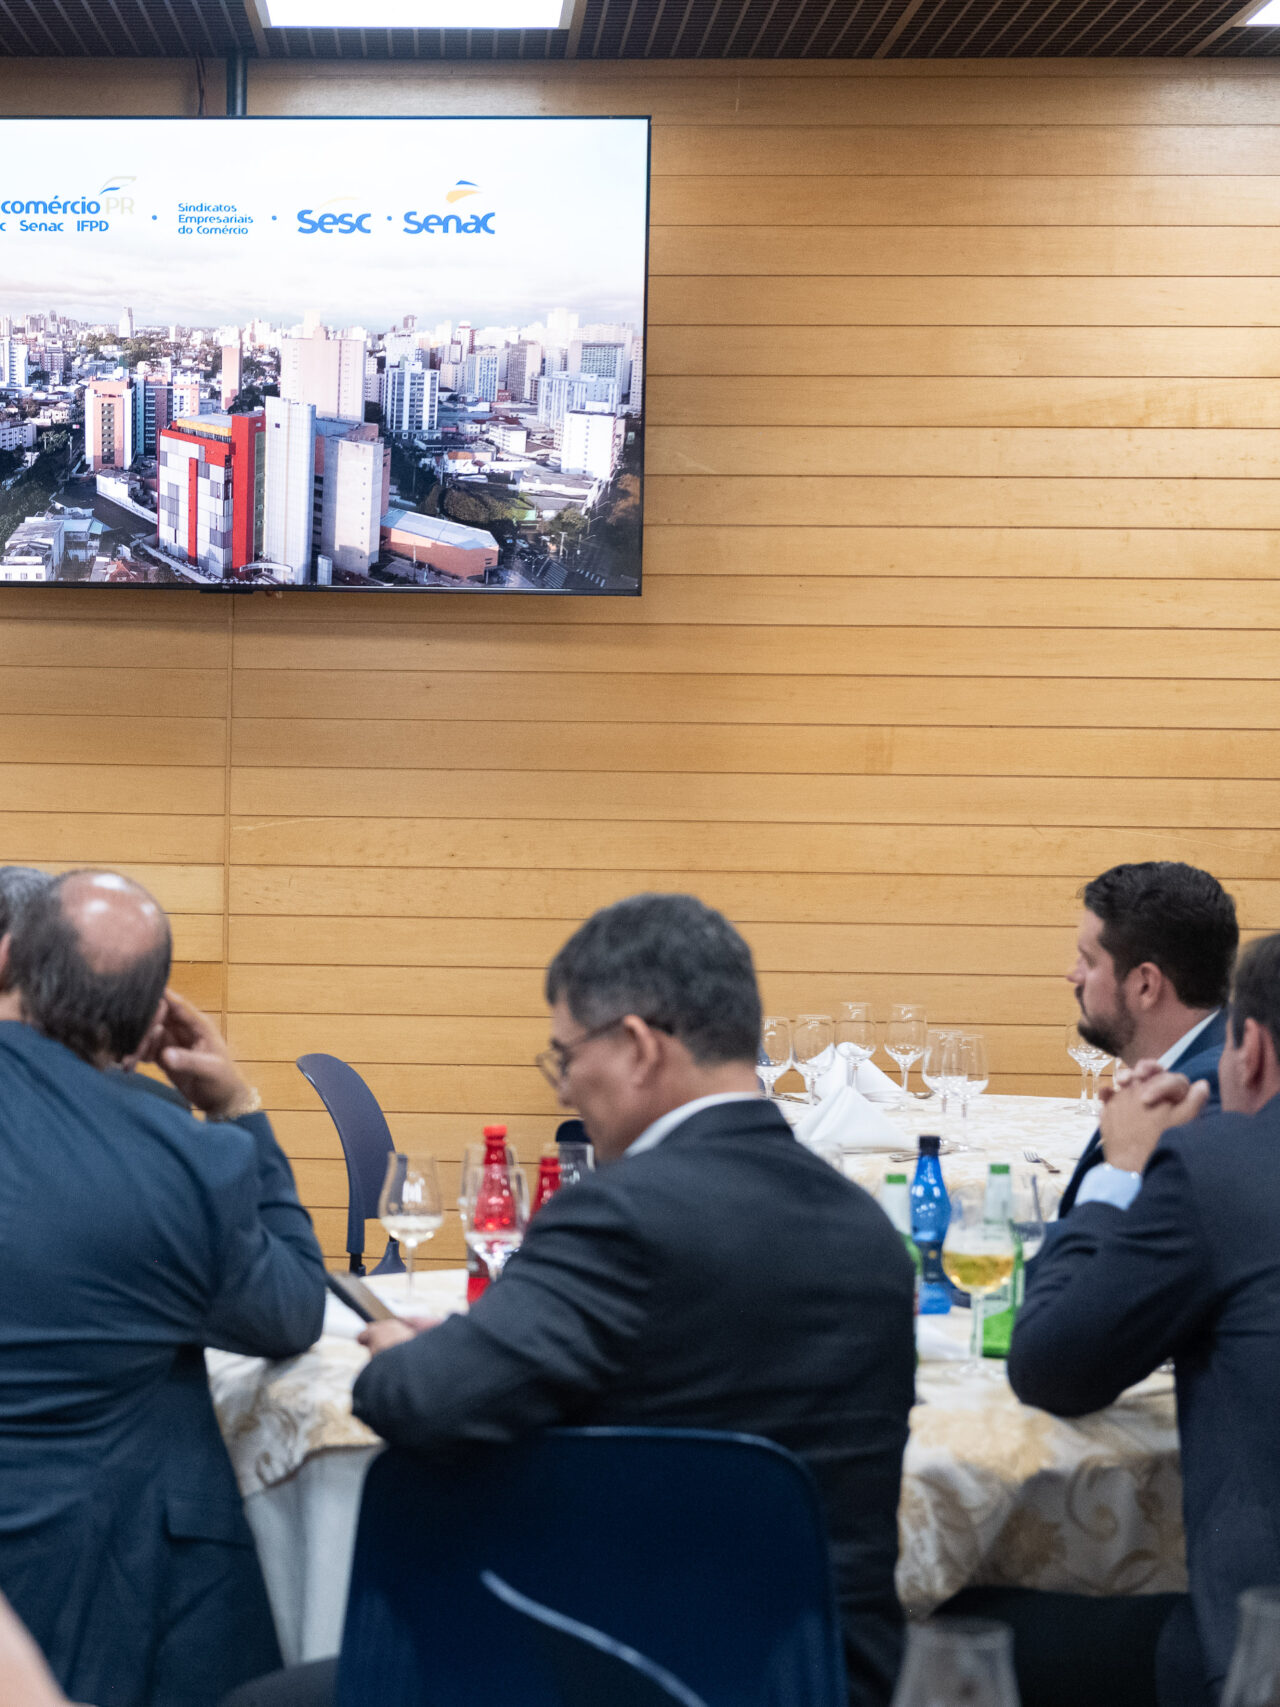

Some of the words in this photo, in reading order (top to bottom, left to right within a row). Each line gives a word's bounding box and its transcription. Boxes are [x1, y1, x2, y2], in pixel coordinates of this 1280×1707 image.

[177, 203, 237, 213] Sindicatos
[177, 214, 254, 224] Empresariais
[297, 209, 371, 234] Sesc
[403, 211, 496, 235] Senac
[19, 219, 64, 232] Senac
[76, 220, 109, 232] IFPD
[177, 225, 193, 235] do
[196, 224, 249, 235] Comércio
